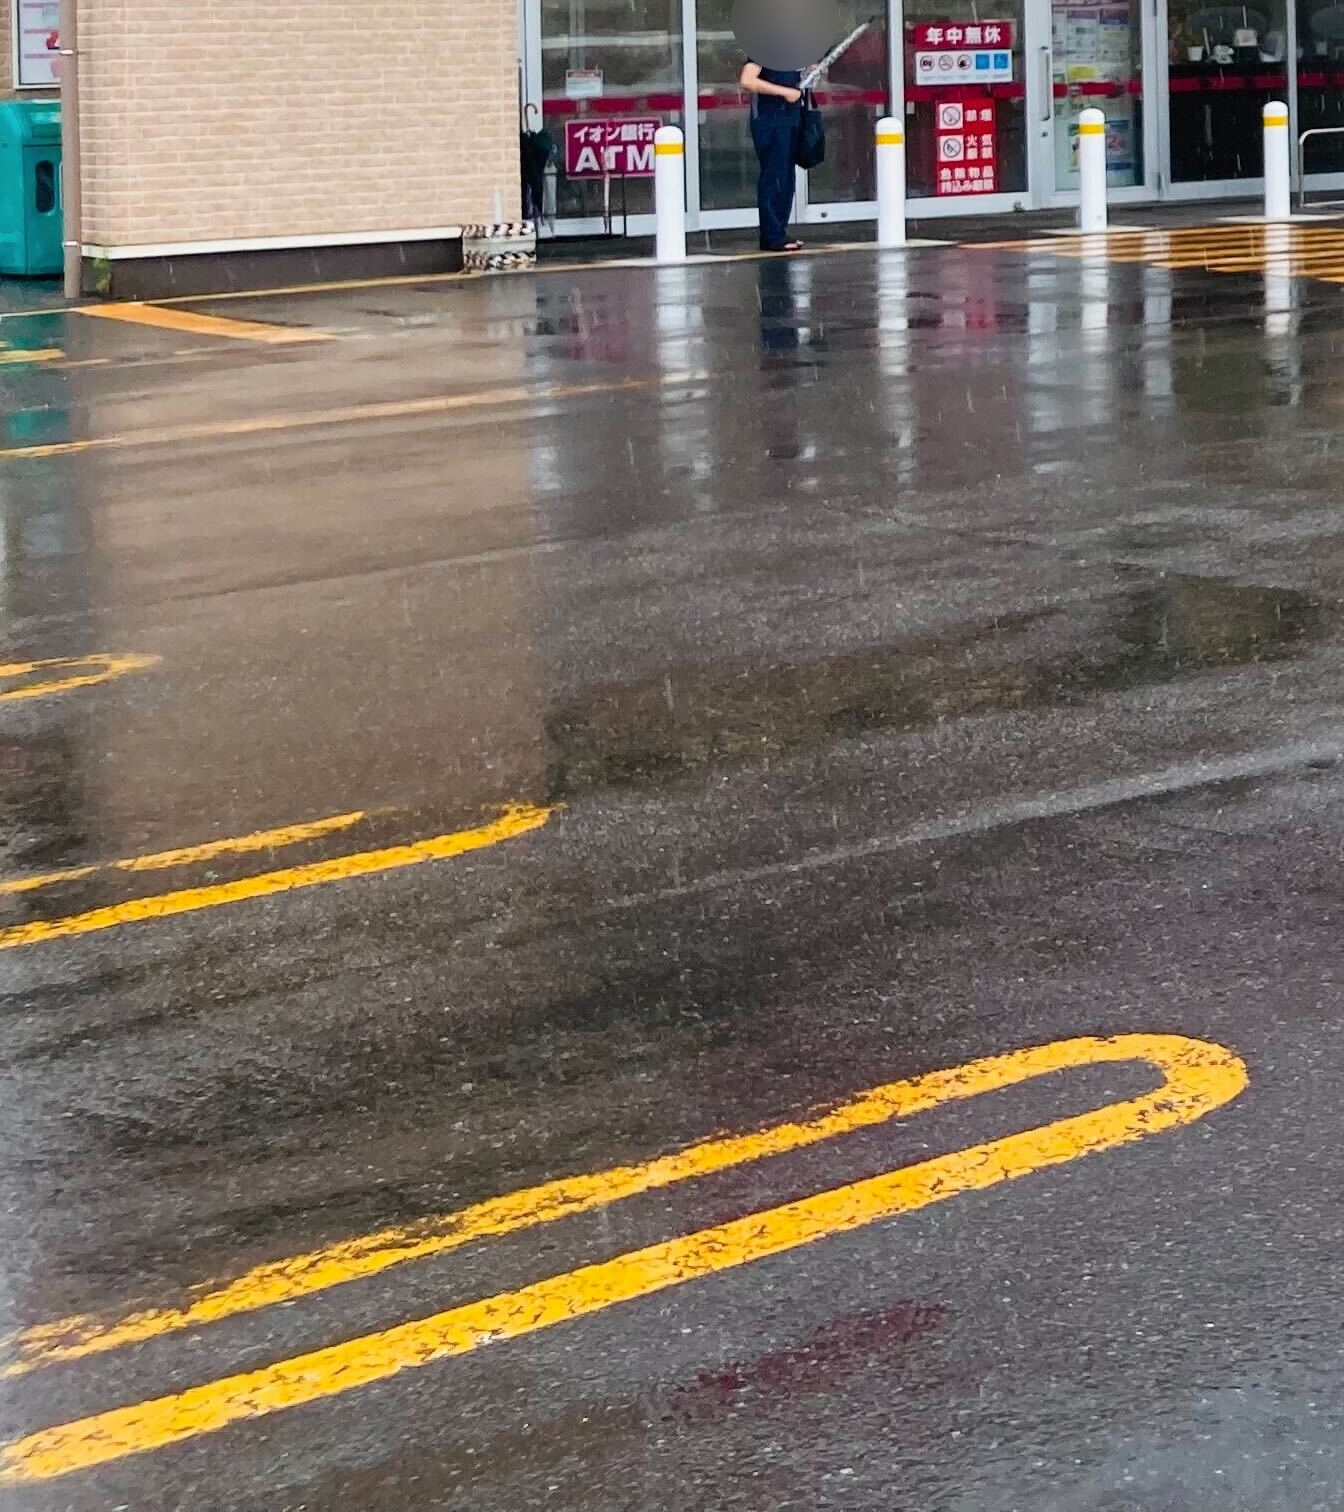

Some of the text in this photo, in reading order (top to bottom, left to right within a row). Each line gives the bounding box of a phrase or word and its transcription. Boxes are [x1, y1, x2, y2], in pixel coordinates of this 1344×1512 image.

[925, 25, 1002, 45] 年中無休
[573, 123, 656, 143] イオン銀行
[575, 144, 656, 173] ATM
